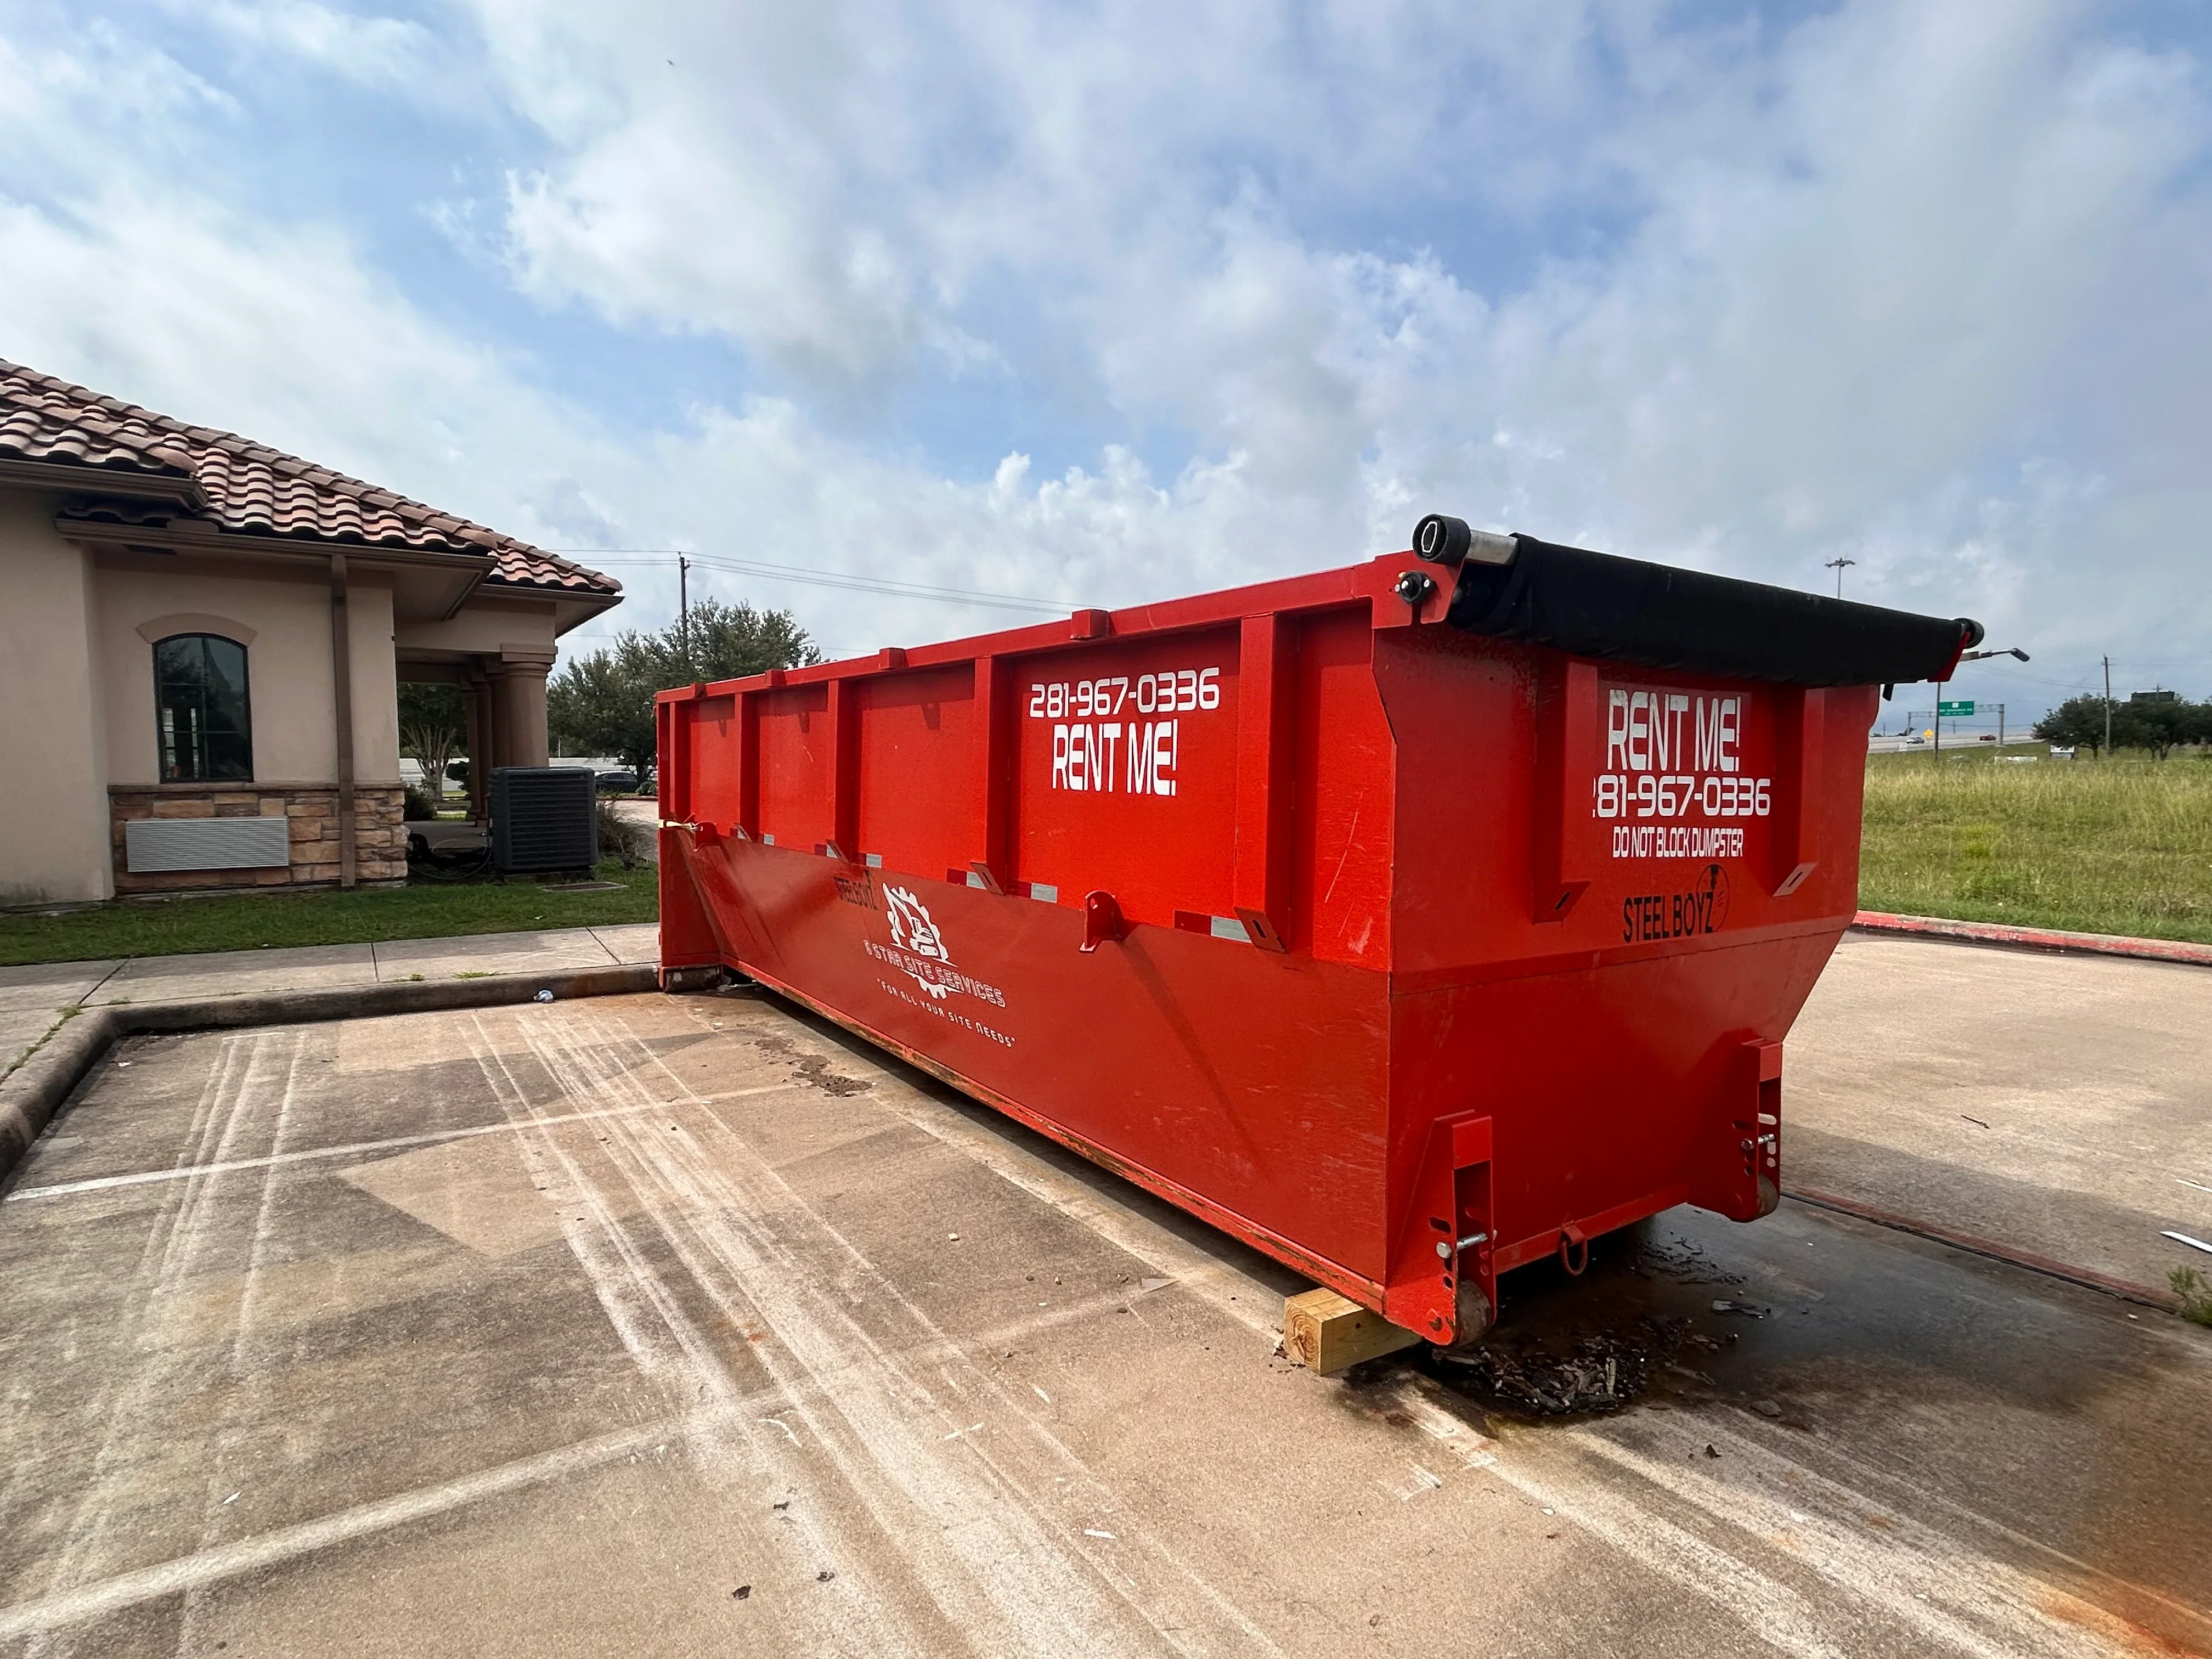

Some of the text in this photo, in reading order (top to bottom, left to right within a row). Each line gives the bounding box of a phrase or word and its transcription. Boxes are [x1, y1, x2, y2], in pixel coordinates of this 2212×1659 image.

[1029, 667, 1220, 718] 281-967-0336
[1607, 689, 1741, 772] RENT ME!
[1052, 719, 1178, 797] RENT ME!
[1592, 774, 1771, 818] 81-967-0336
[1612, 826, 1743, 858] DO NOT BLOCK DUMPSTER
[1623, 891, 1714, 943] STEEL BOYZ
[871, 943, 905, 969] STAR
[904, 955, 934, 980] SITE
[935, 966, 1006, 1008] SERVICES
[900, 991, 918, 1006] ALL
[919, 999, 945, 1018] YOUR
[948, 1012, 972, 1030] SITE
